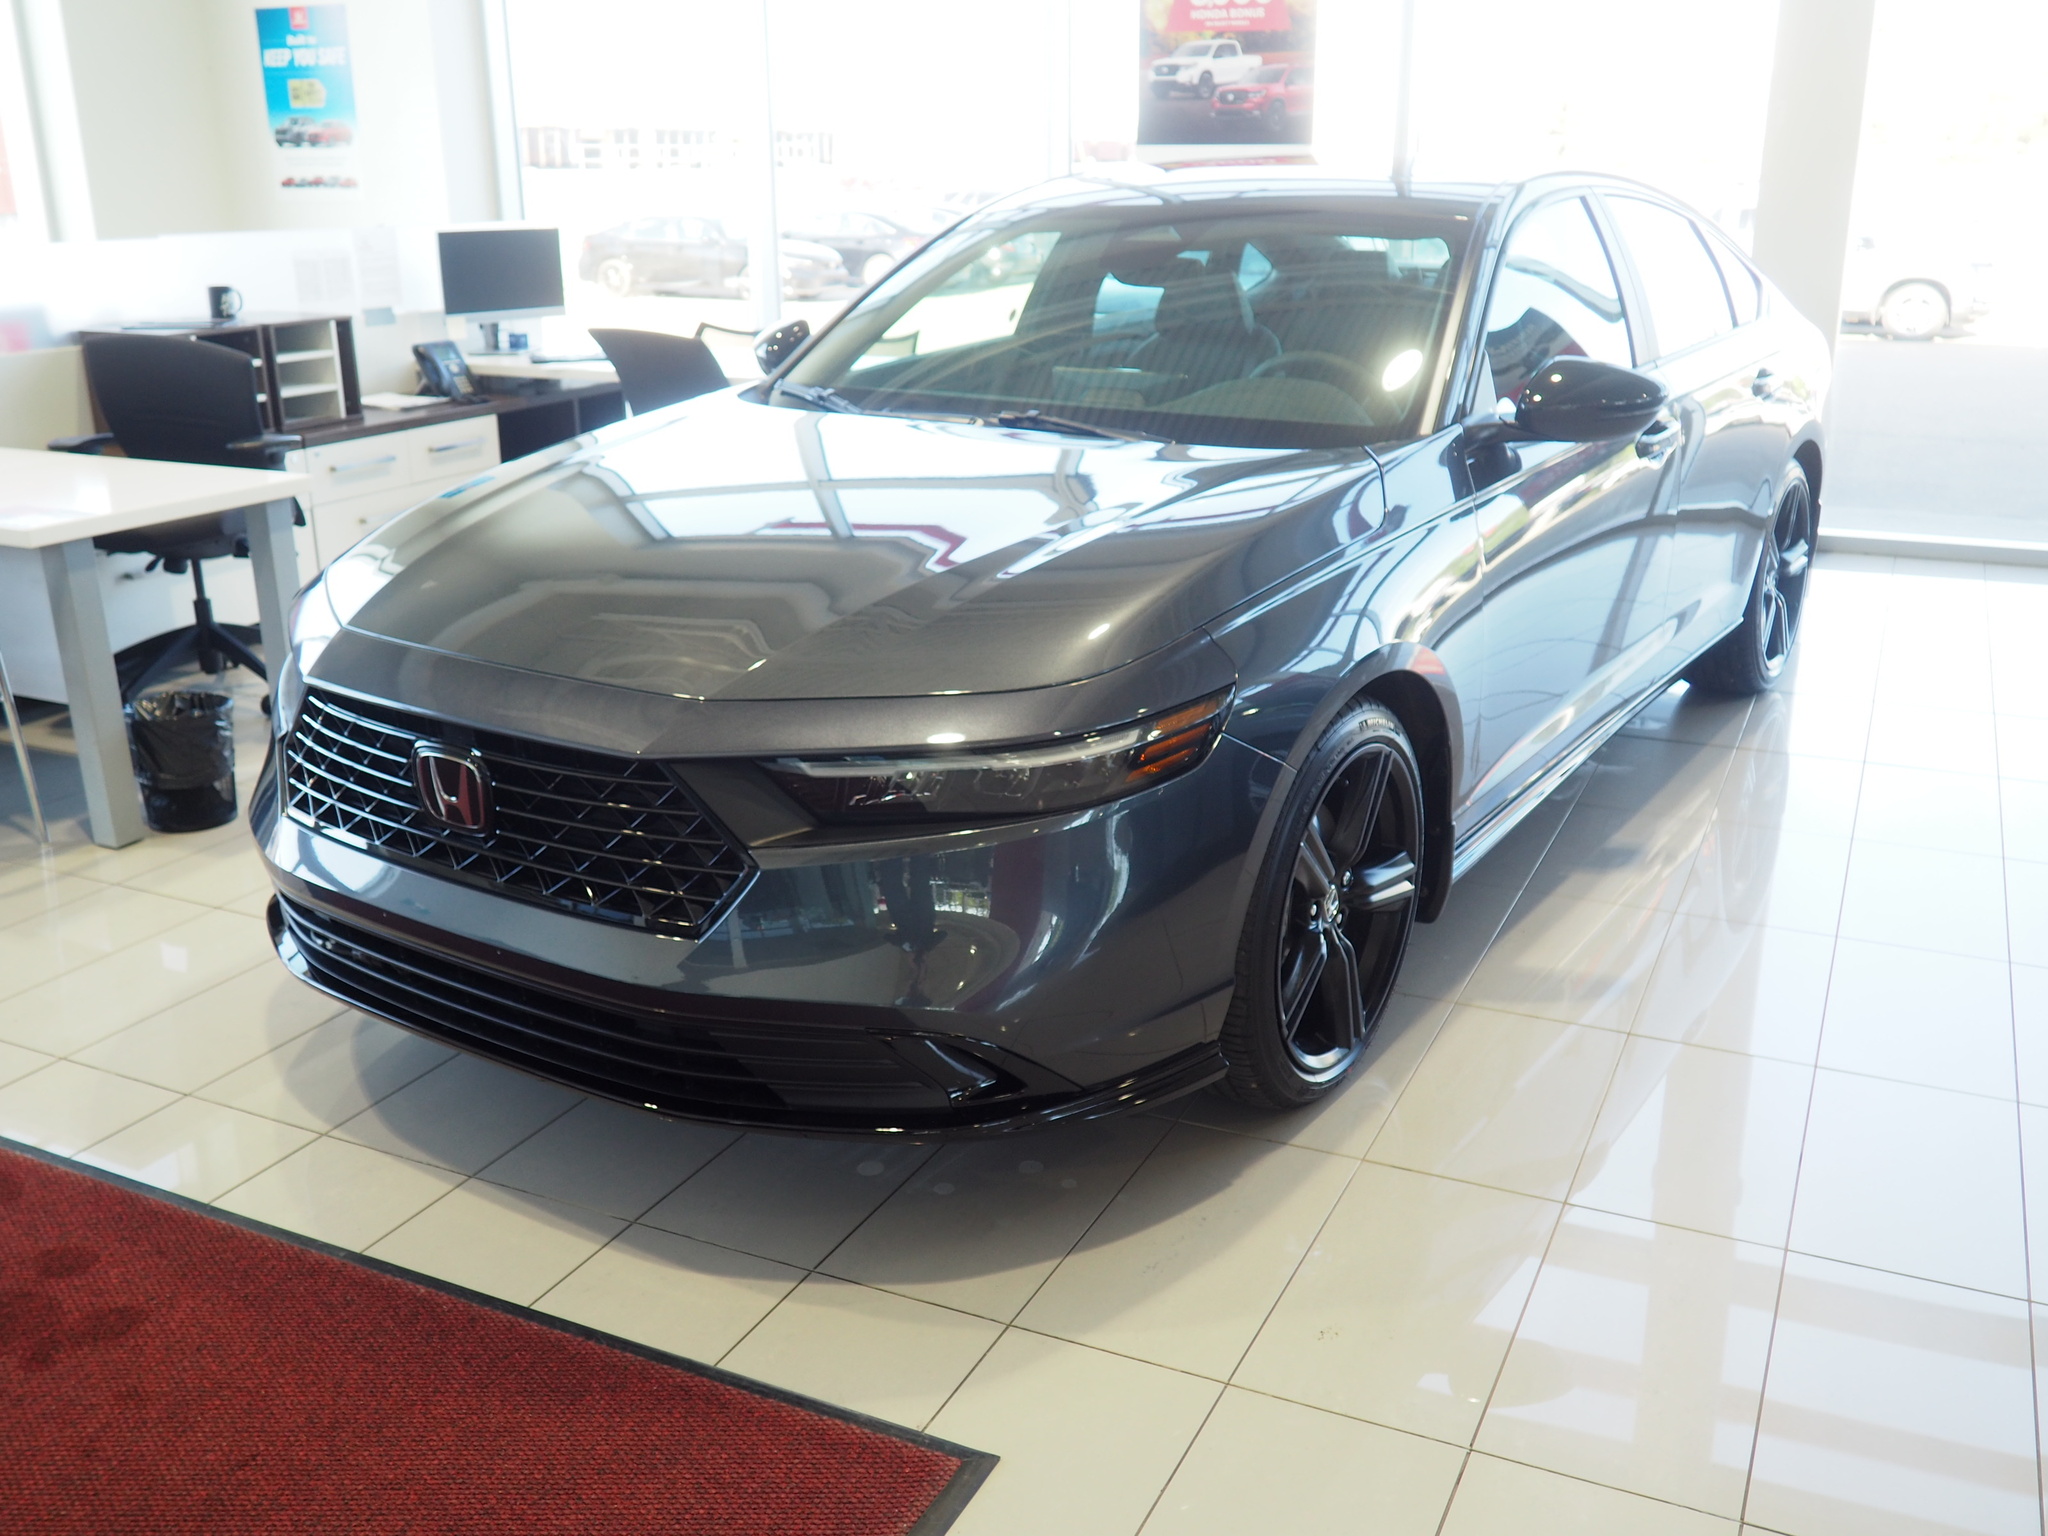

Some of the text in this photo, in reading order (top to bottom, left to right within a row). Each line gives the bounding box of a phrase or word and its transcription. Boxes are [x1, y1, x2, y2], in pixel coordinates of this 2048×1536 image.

[1190, 7, 1265, 19] HONDA BONUS
[264, 47, 346, 67] KEEP YOU SAFE
[1367, 718, 1394, 729] MICHELIN
